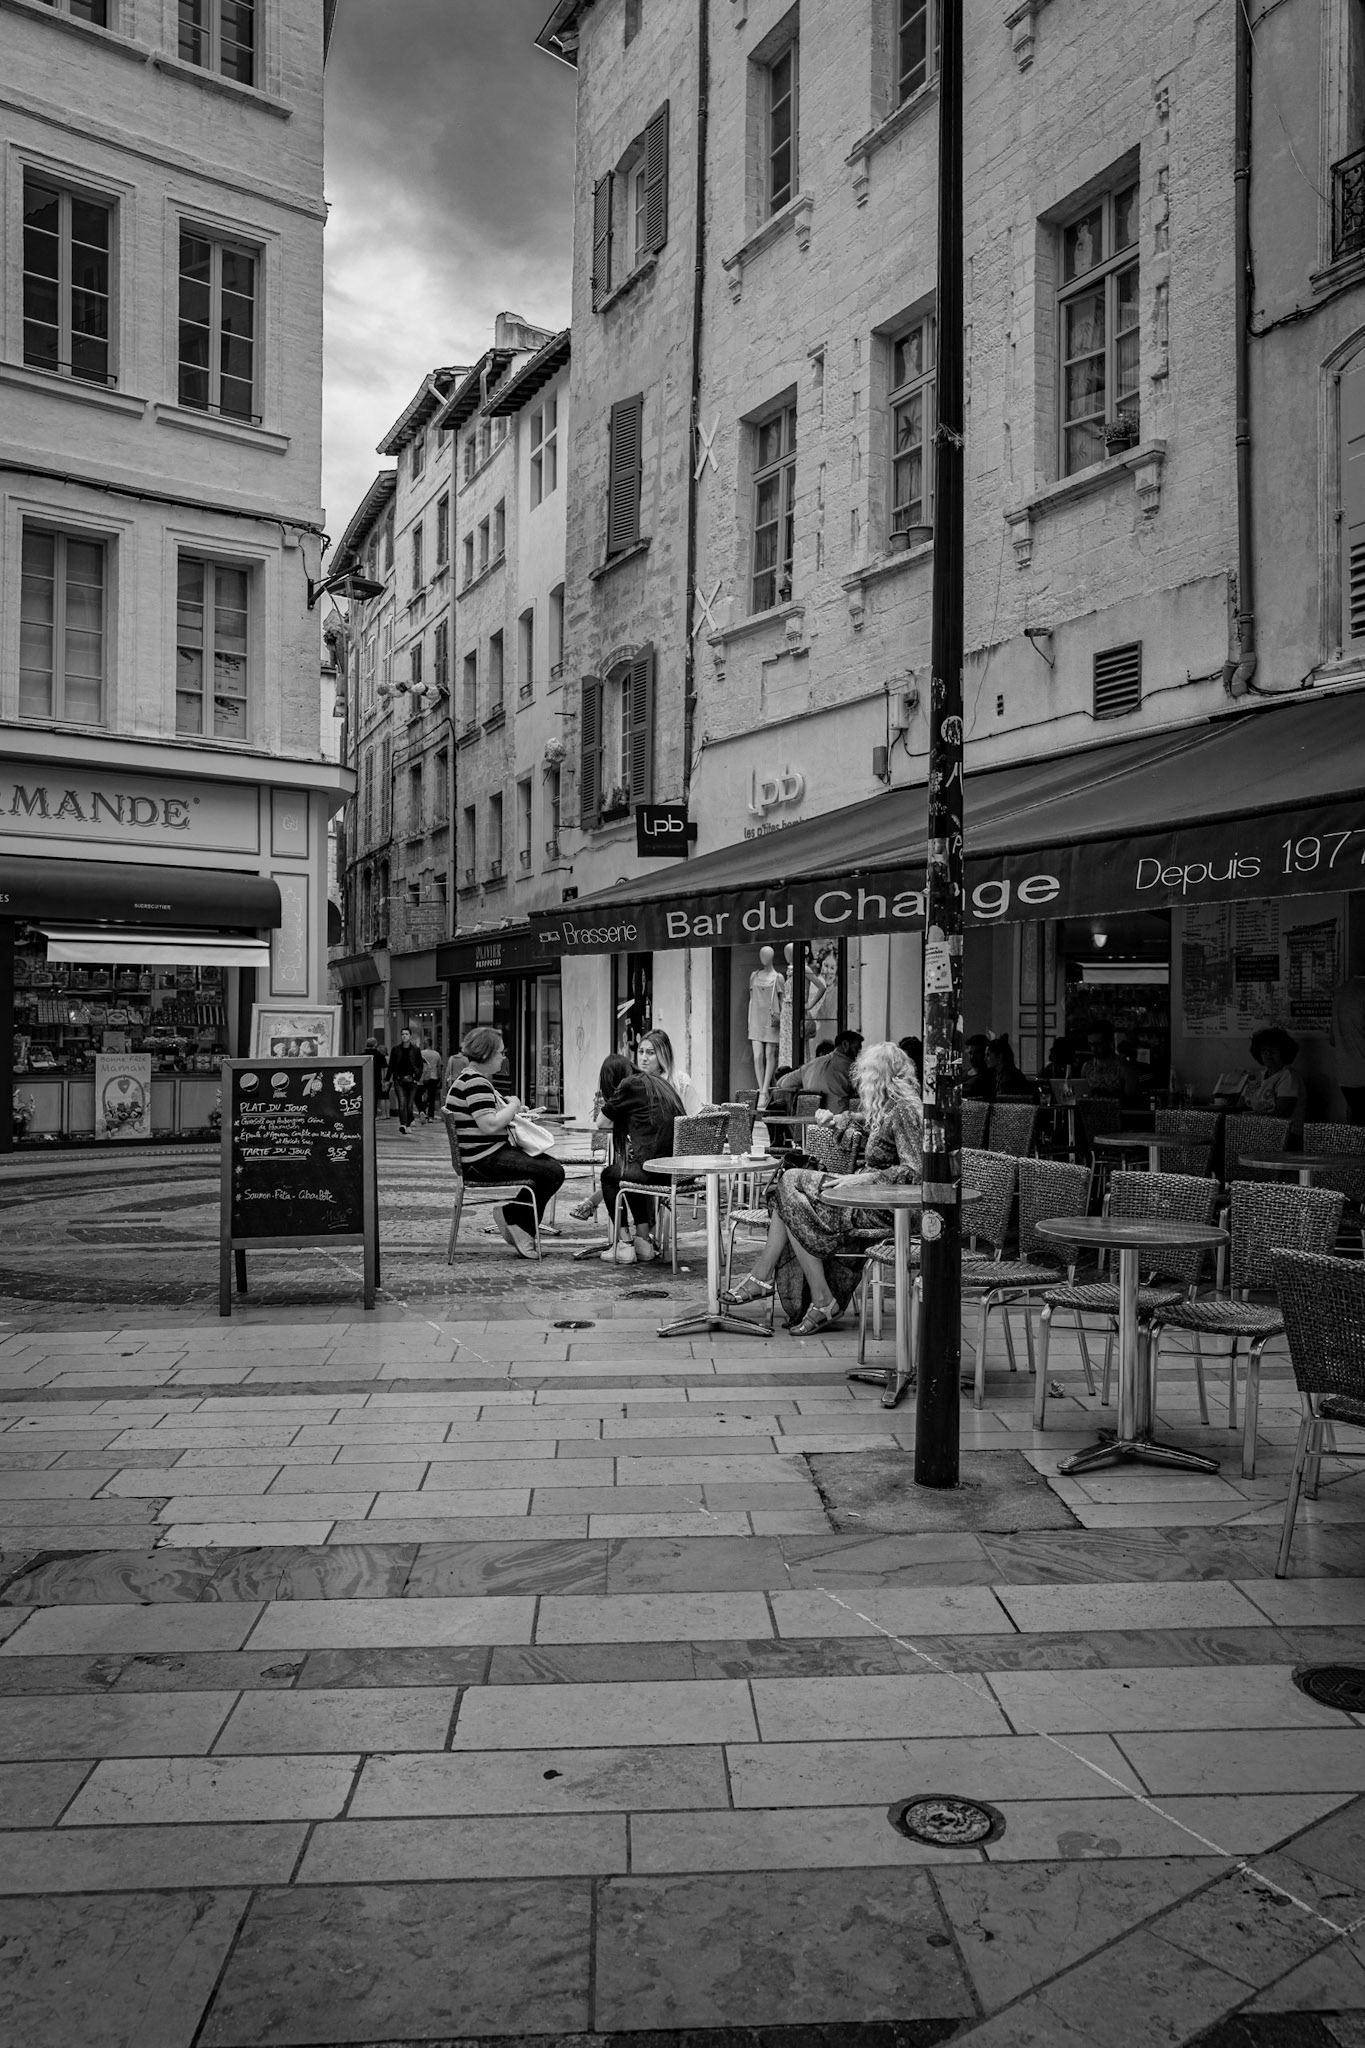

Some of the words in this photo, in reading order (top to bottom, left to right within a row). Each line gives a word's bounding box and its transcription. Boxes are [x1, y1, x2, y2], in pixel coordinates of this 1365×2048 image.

[0, 784, 190, 830] MANDE
[643, 812, 685, 837] lpb
[744, 827, 756, 839] les
[1136, 852, 1261, 895] Depuis
[666, 911, 730, 939] Bar
[742, 901, 793, 932] du
[814, 874, 1061, 924] Chage
[563, 920, 637, 945] Brasserie
[100, 1064, 146, 1072] Maman
[240, 1102, 267, 1112] PLAT
[267, 1103, 281, 1112] DU
[284, 1104, 308, 1112] JOUR
[240, 1147, 272, 1156] TARTE
[288, 1147, 312, 1156] JOUR
